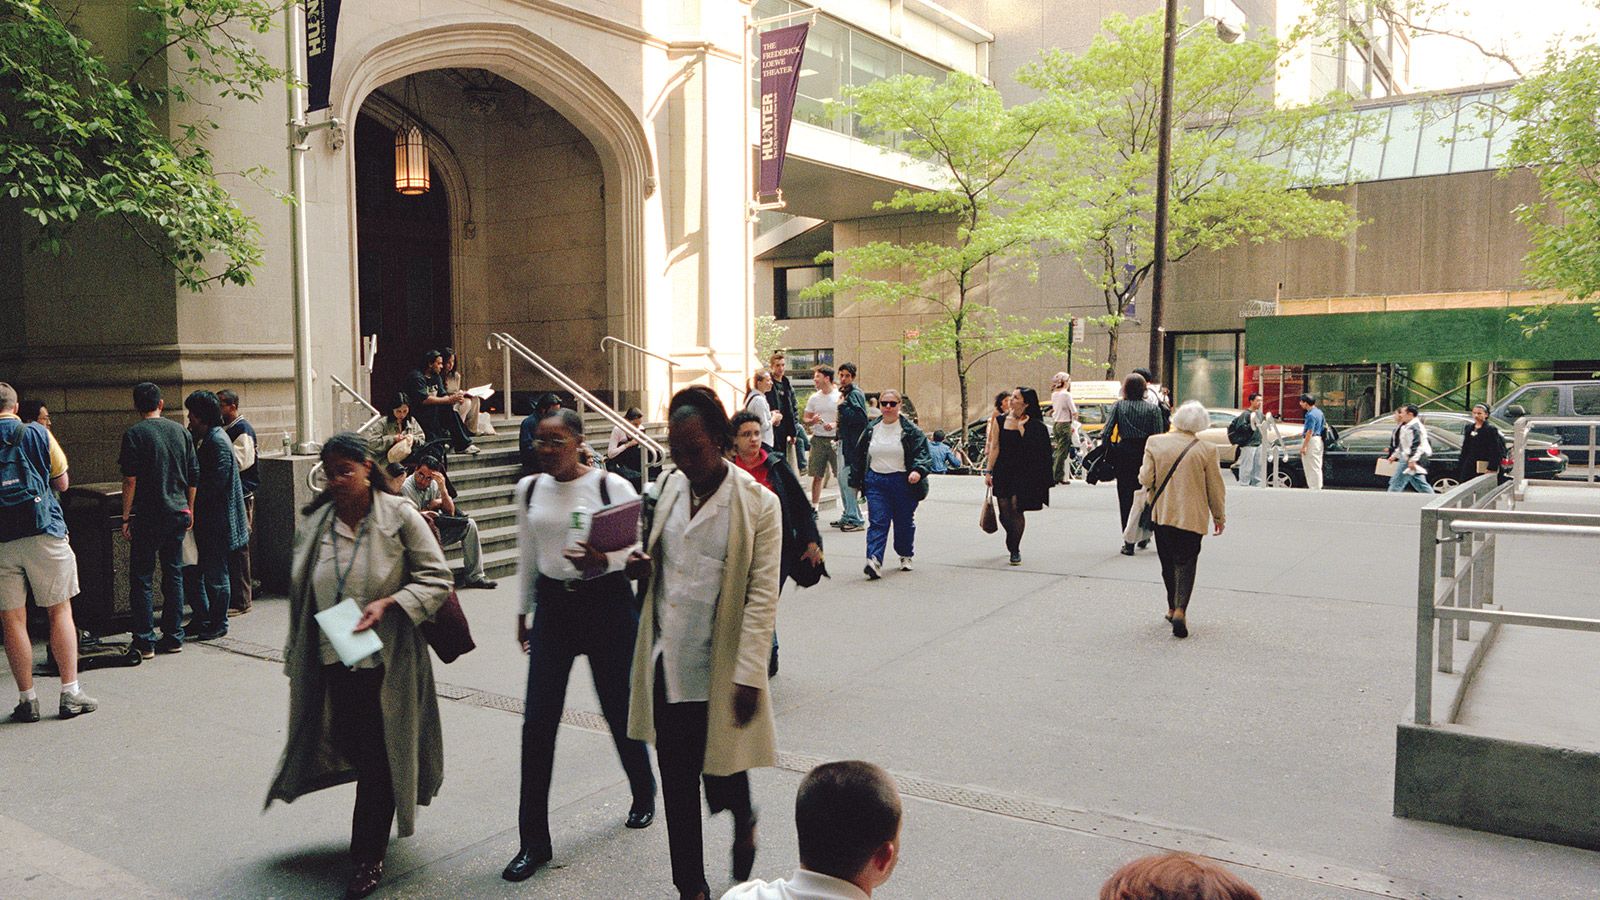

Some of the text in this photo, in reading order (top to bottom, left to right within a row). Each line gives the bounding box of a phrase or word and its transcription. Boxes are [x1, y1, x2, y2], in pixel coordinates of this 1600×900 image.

[762, 42, 776, 50] THE
[763, 46, 801, 60] FREDERICK
[763, 58, 786, 69] LOEWE
[763, 65, 793, 77] THEATER
[762, 92, 774, 161] HUNTER
